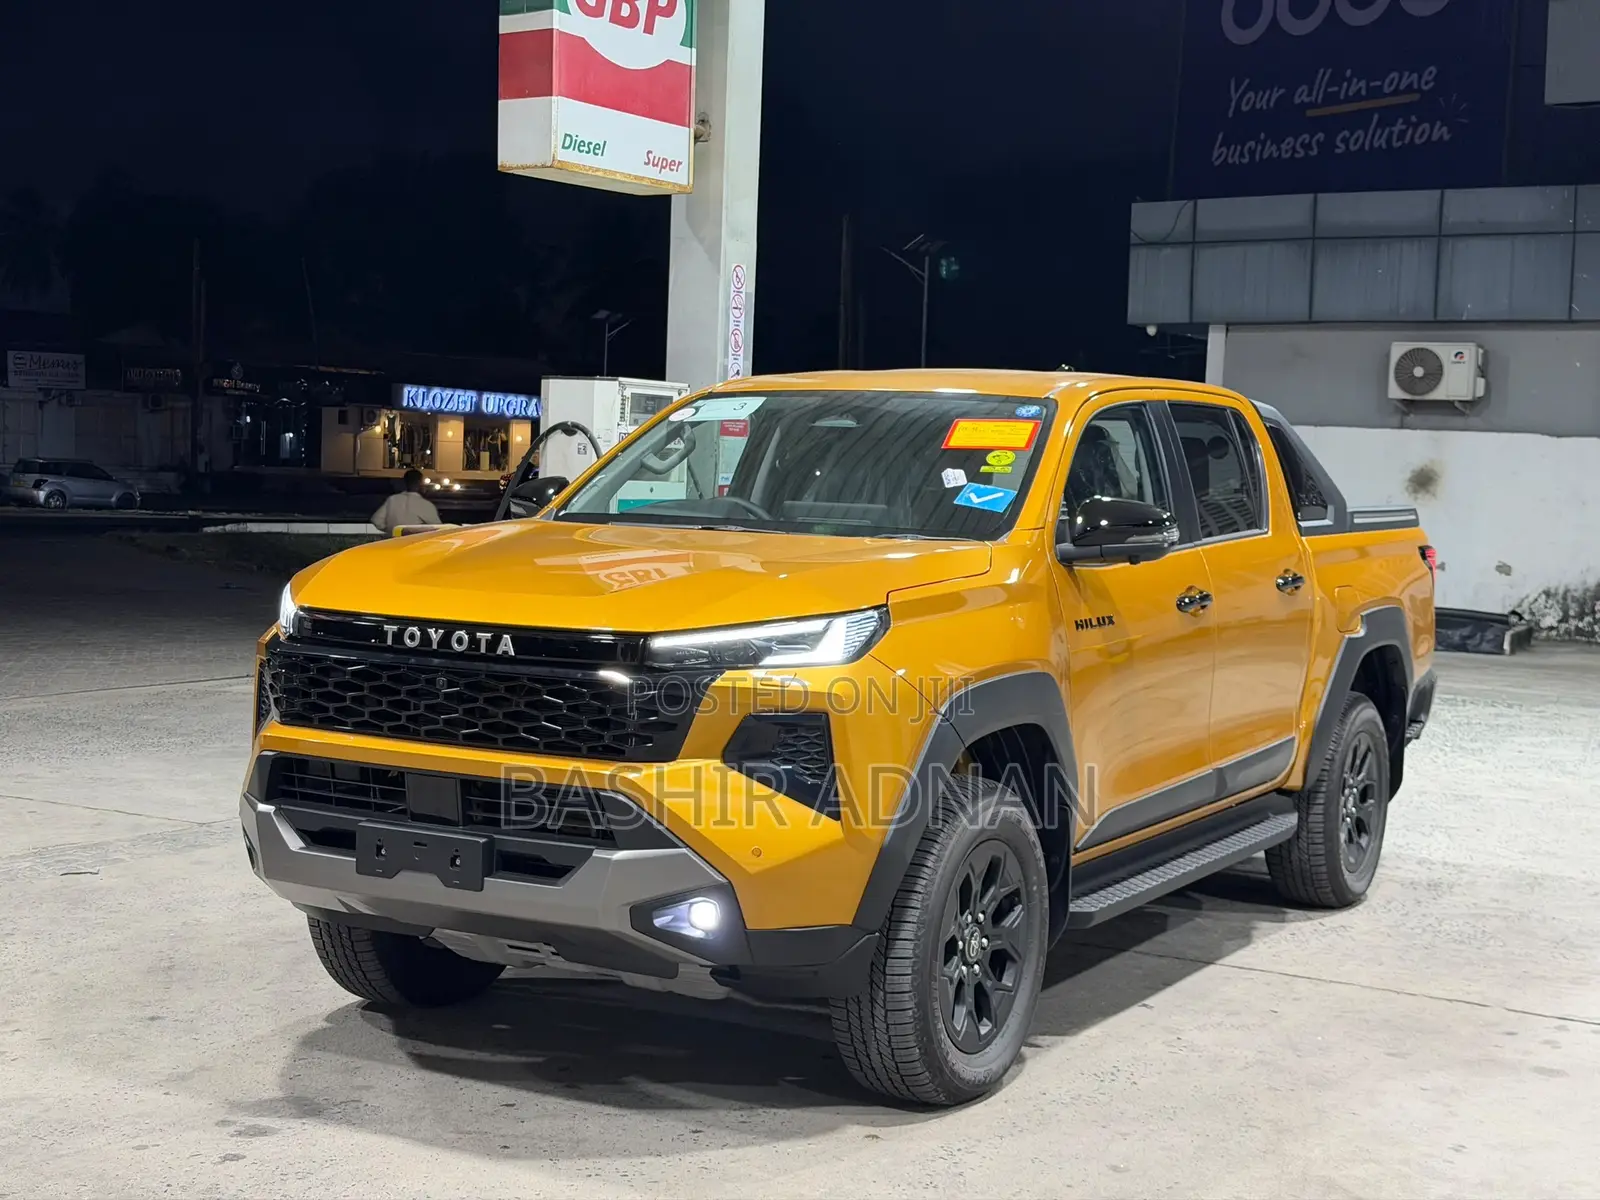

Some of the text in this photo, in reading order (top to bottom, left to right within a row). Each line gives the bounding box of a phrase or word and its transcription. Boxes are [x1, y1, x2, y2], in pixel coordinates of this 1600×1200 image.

[1227, 65, 1438, 118] Your all-in-one
[561, 132, 607, 157] Diesel
[1211, 114, 1453, 168] business solution
[644, 150, 682, 173] Super
[402, 386, 477, 412] KLOZET
[1074, 615, 1115, 631] HILUX
[383, 625, 515, 656] TOYOTA
